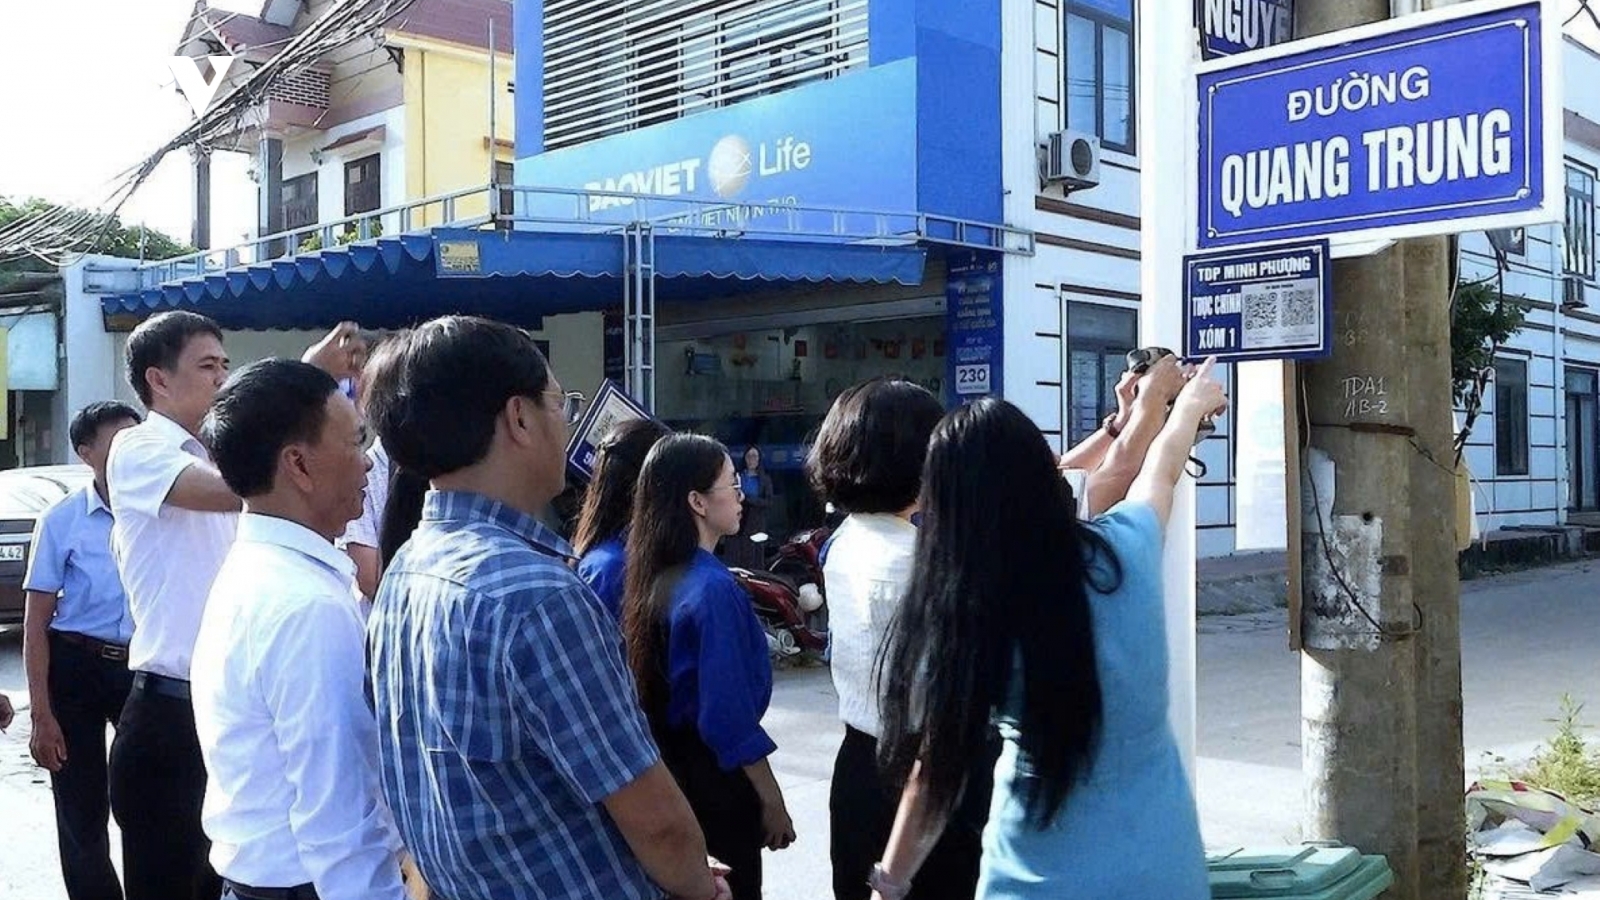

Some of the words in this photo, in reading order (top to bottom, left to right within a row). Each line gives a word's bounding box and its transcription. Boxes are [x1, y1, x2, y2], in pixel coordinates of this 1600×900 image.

[1287, 66, 1430, 121] ĐƯỜNG
[758, 137, 811, 176] Life
[1221, 135, 1350, 217] QUANG
[1363, 109, 1511, 192] TRUNG
[1224, 262, 1257, 279] MINH
[1198, 323, 1226, 350] XÓM
[1229, 327, 1236, 347] 1
[959, 369, 986, 383] 230
